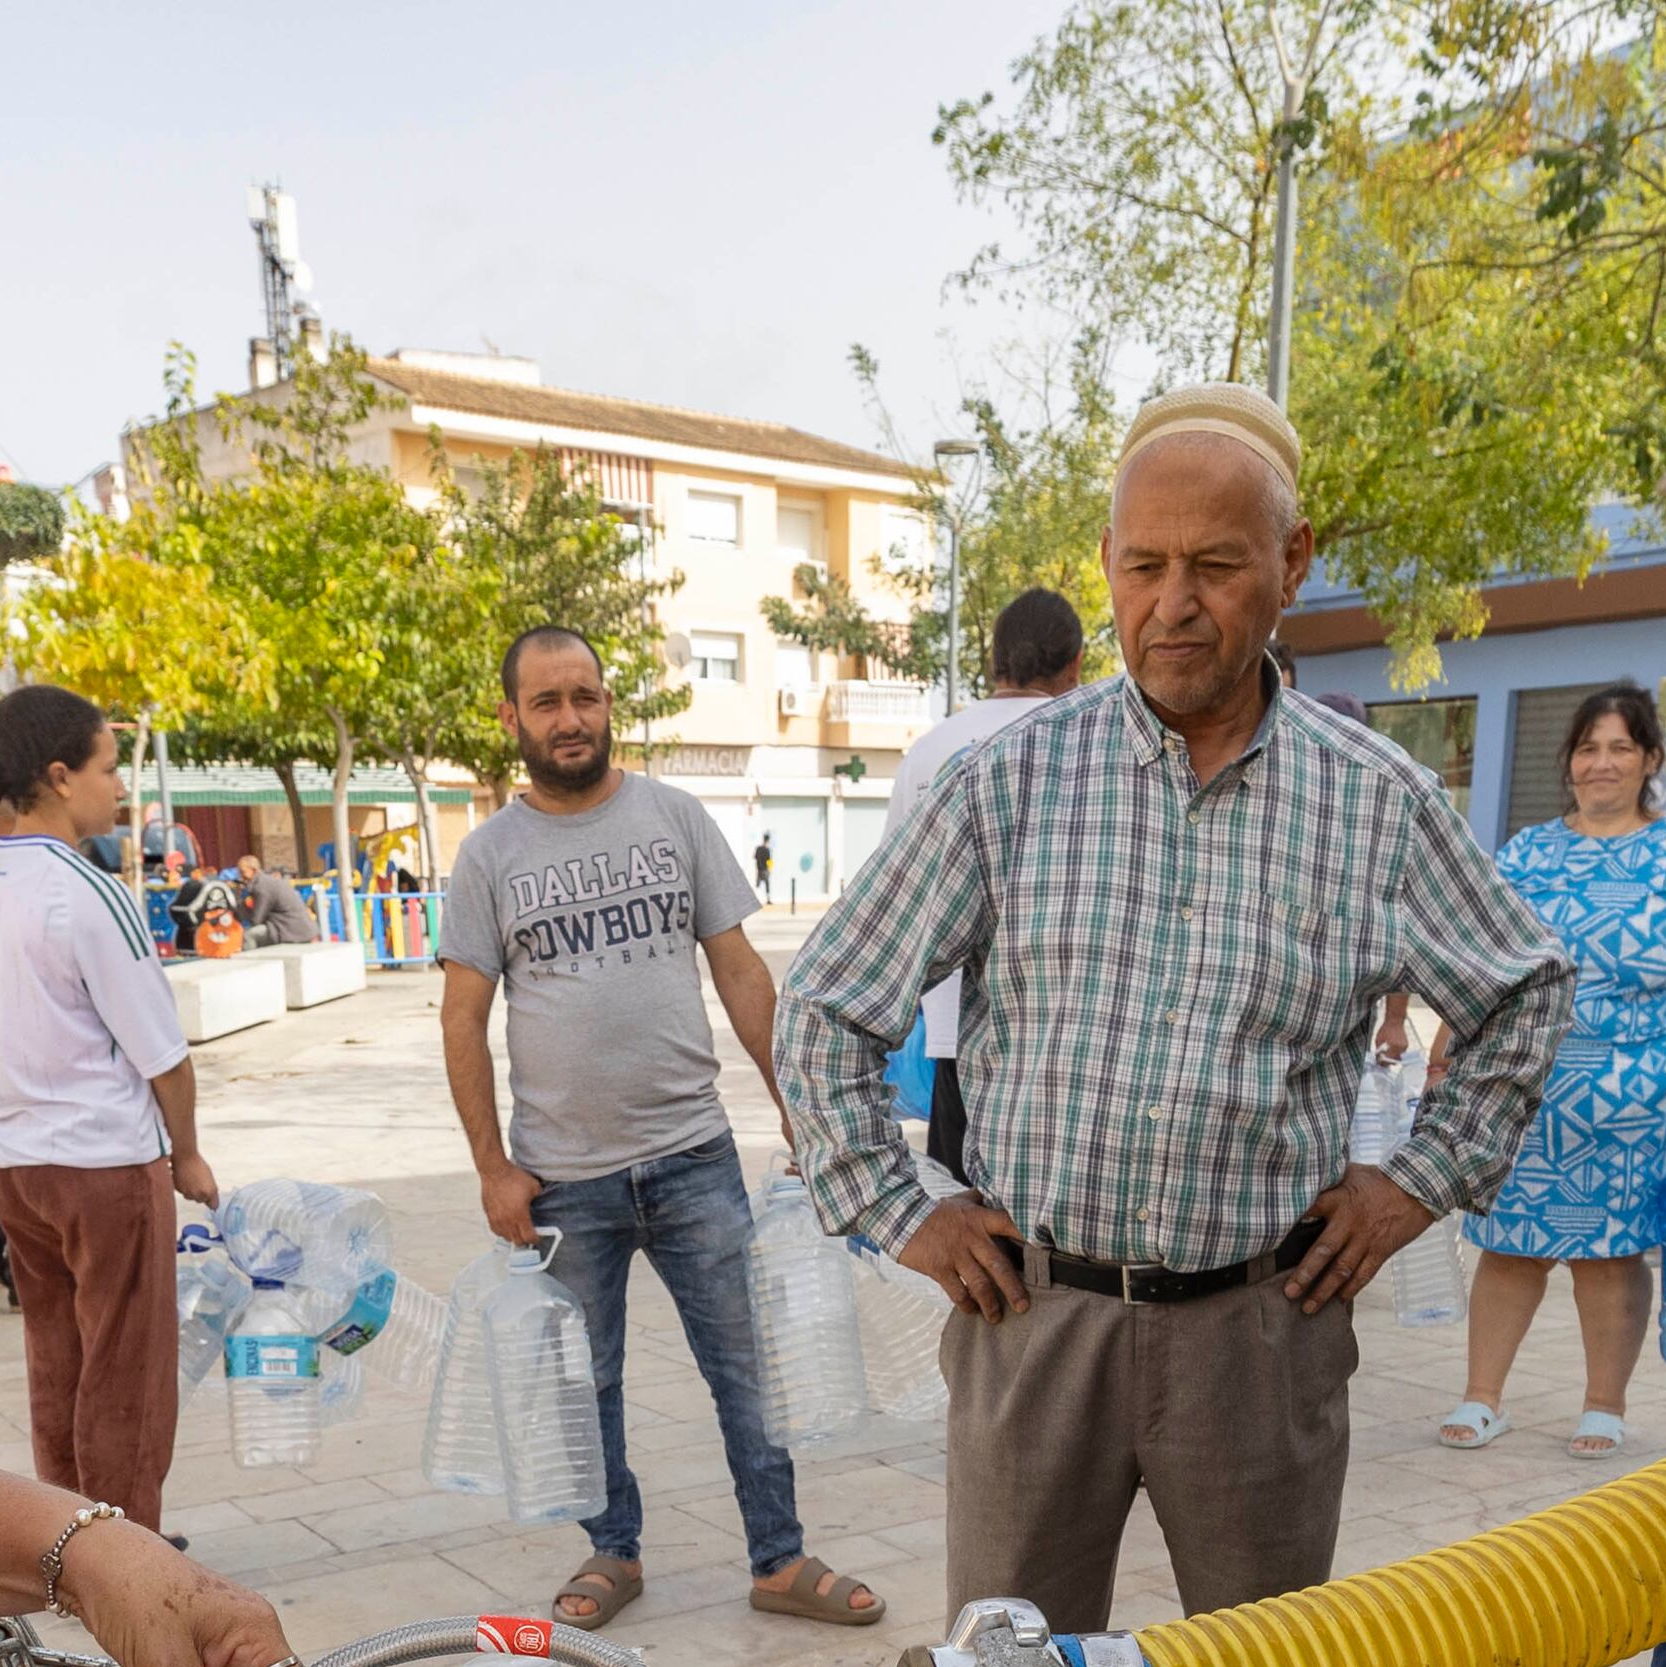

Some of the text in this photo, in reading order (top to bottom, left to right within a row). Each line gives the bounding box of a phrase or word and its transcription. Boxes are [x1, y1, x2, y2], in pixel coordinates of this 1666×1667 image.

[663, 751, 745, 775] FARMACIA
[509, 838, 680, 920] DALLAS
[515, 891, 690, 963] COWBOYS
